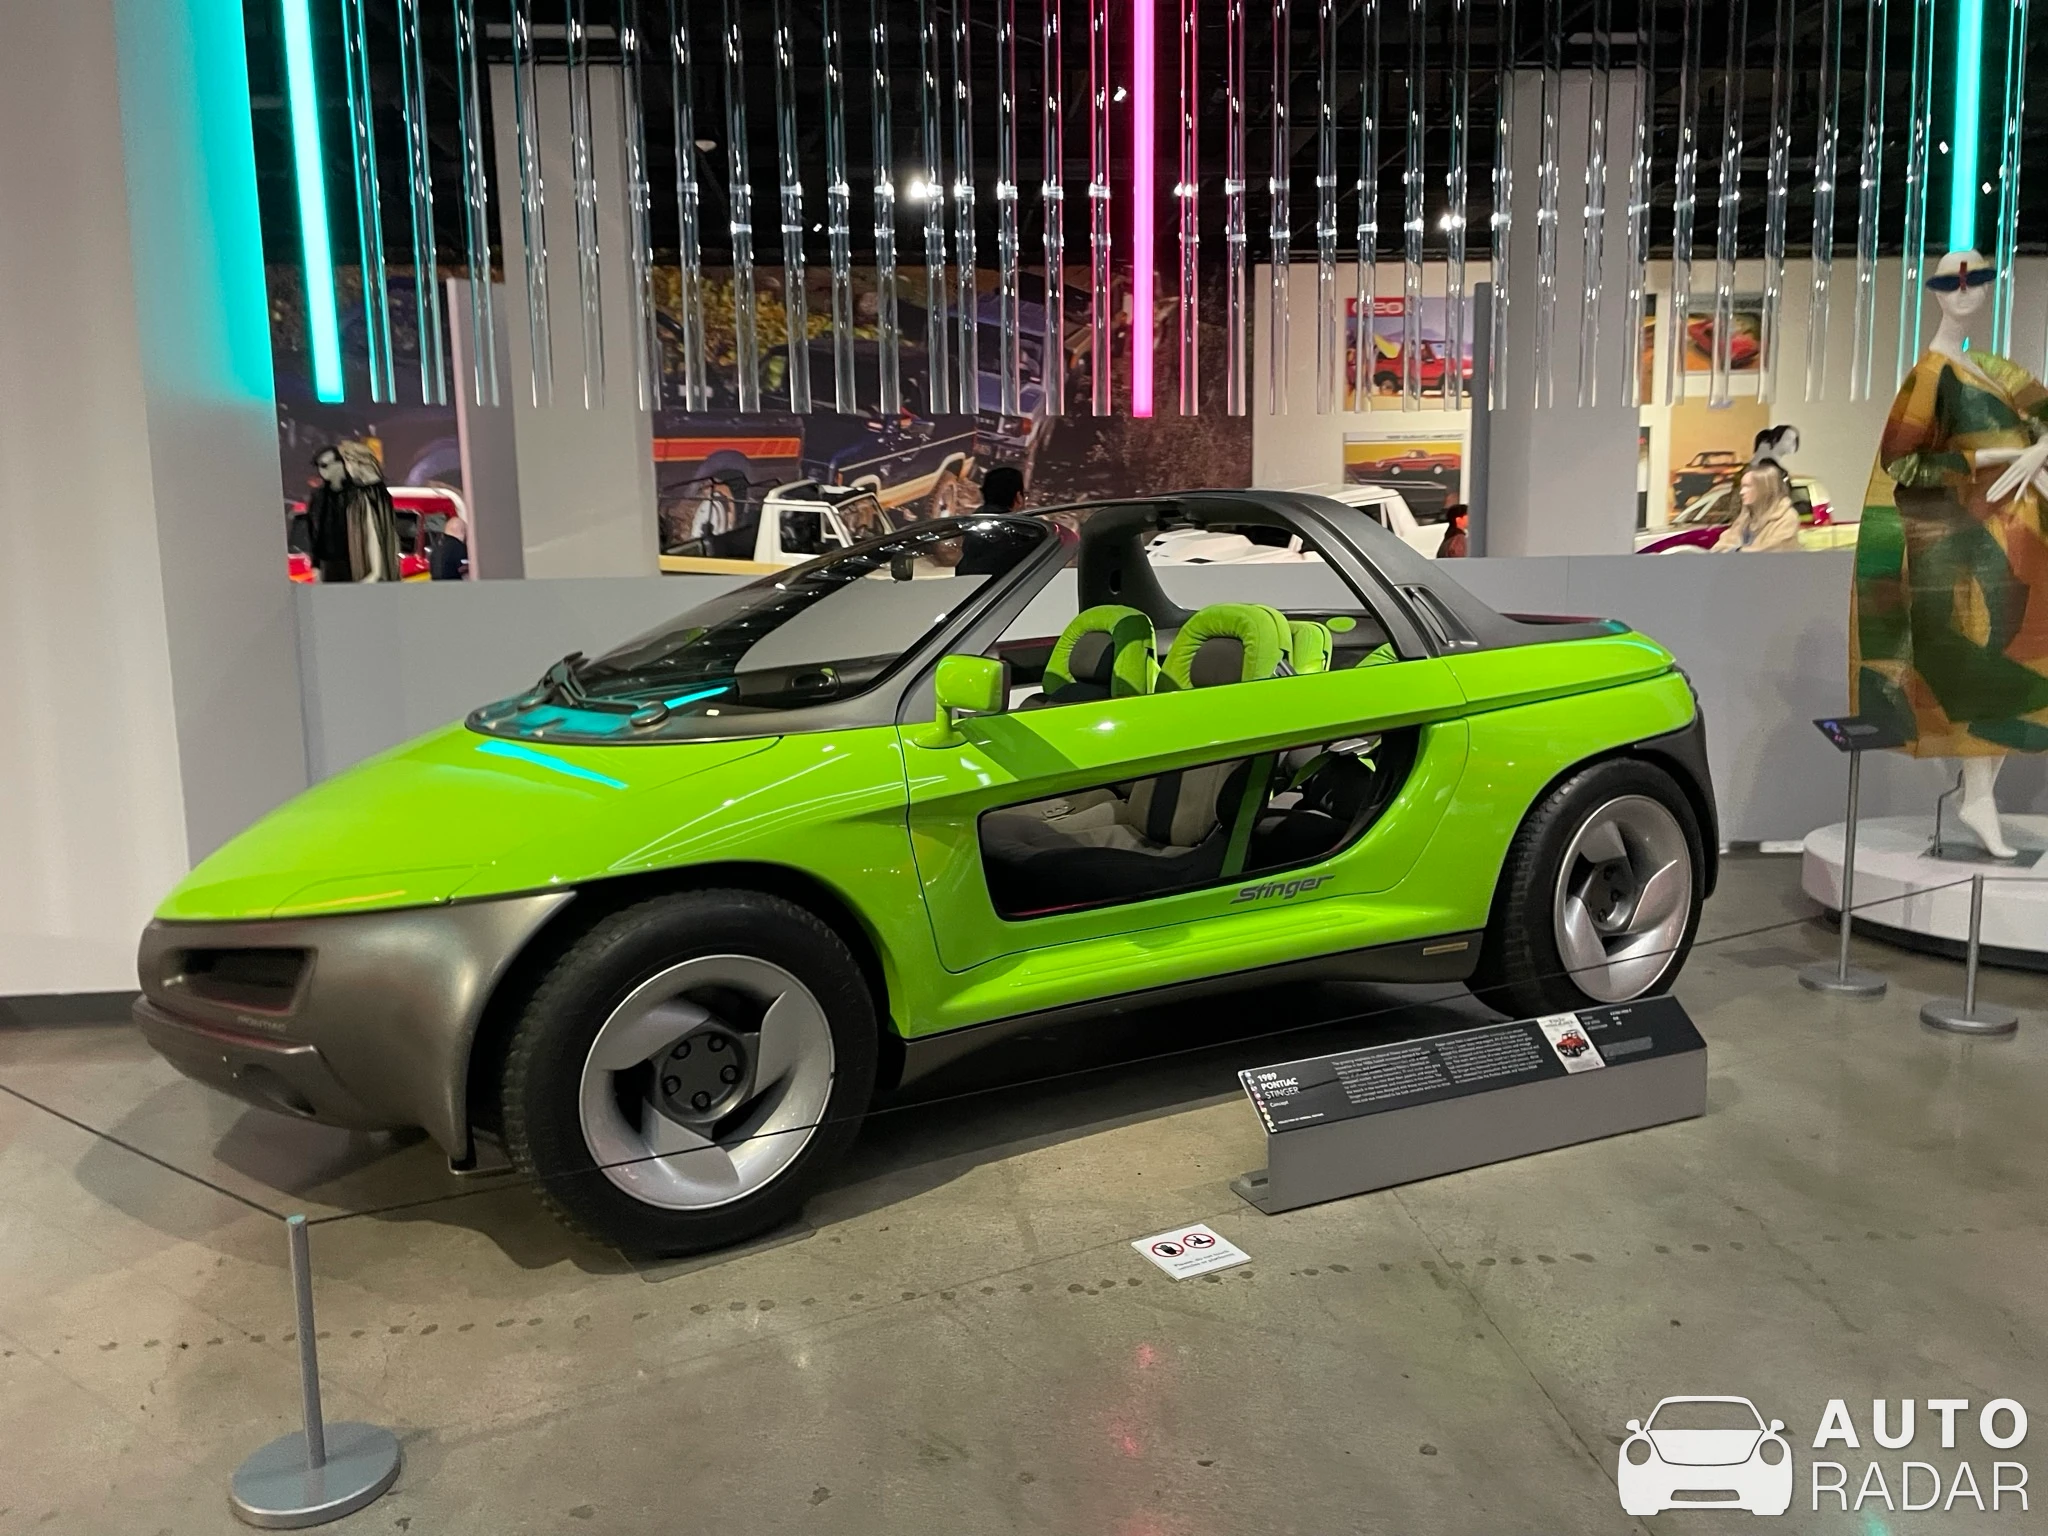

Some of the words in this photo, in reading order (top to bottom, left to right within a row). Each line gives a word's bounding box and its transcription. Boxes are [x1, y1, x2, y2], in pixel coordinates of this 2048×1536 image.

[1229, 874, 1336, 904] Stinger
[1257, 1072, 1277, 1082] 1989
[1261, 1077, 1298, 1090] PONTIAC
[1265, 1086, 1300, 1099] STINGER
